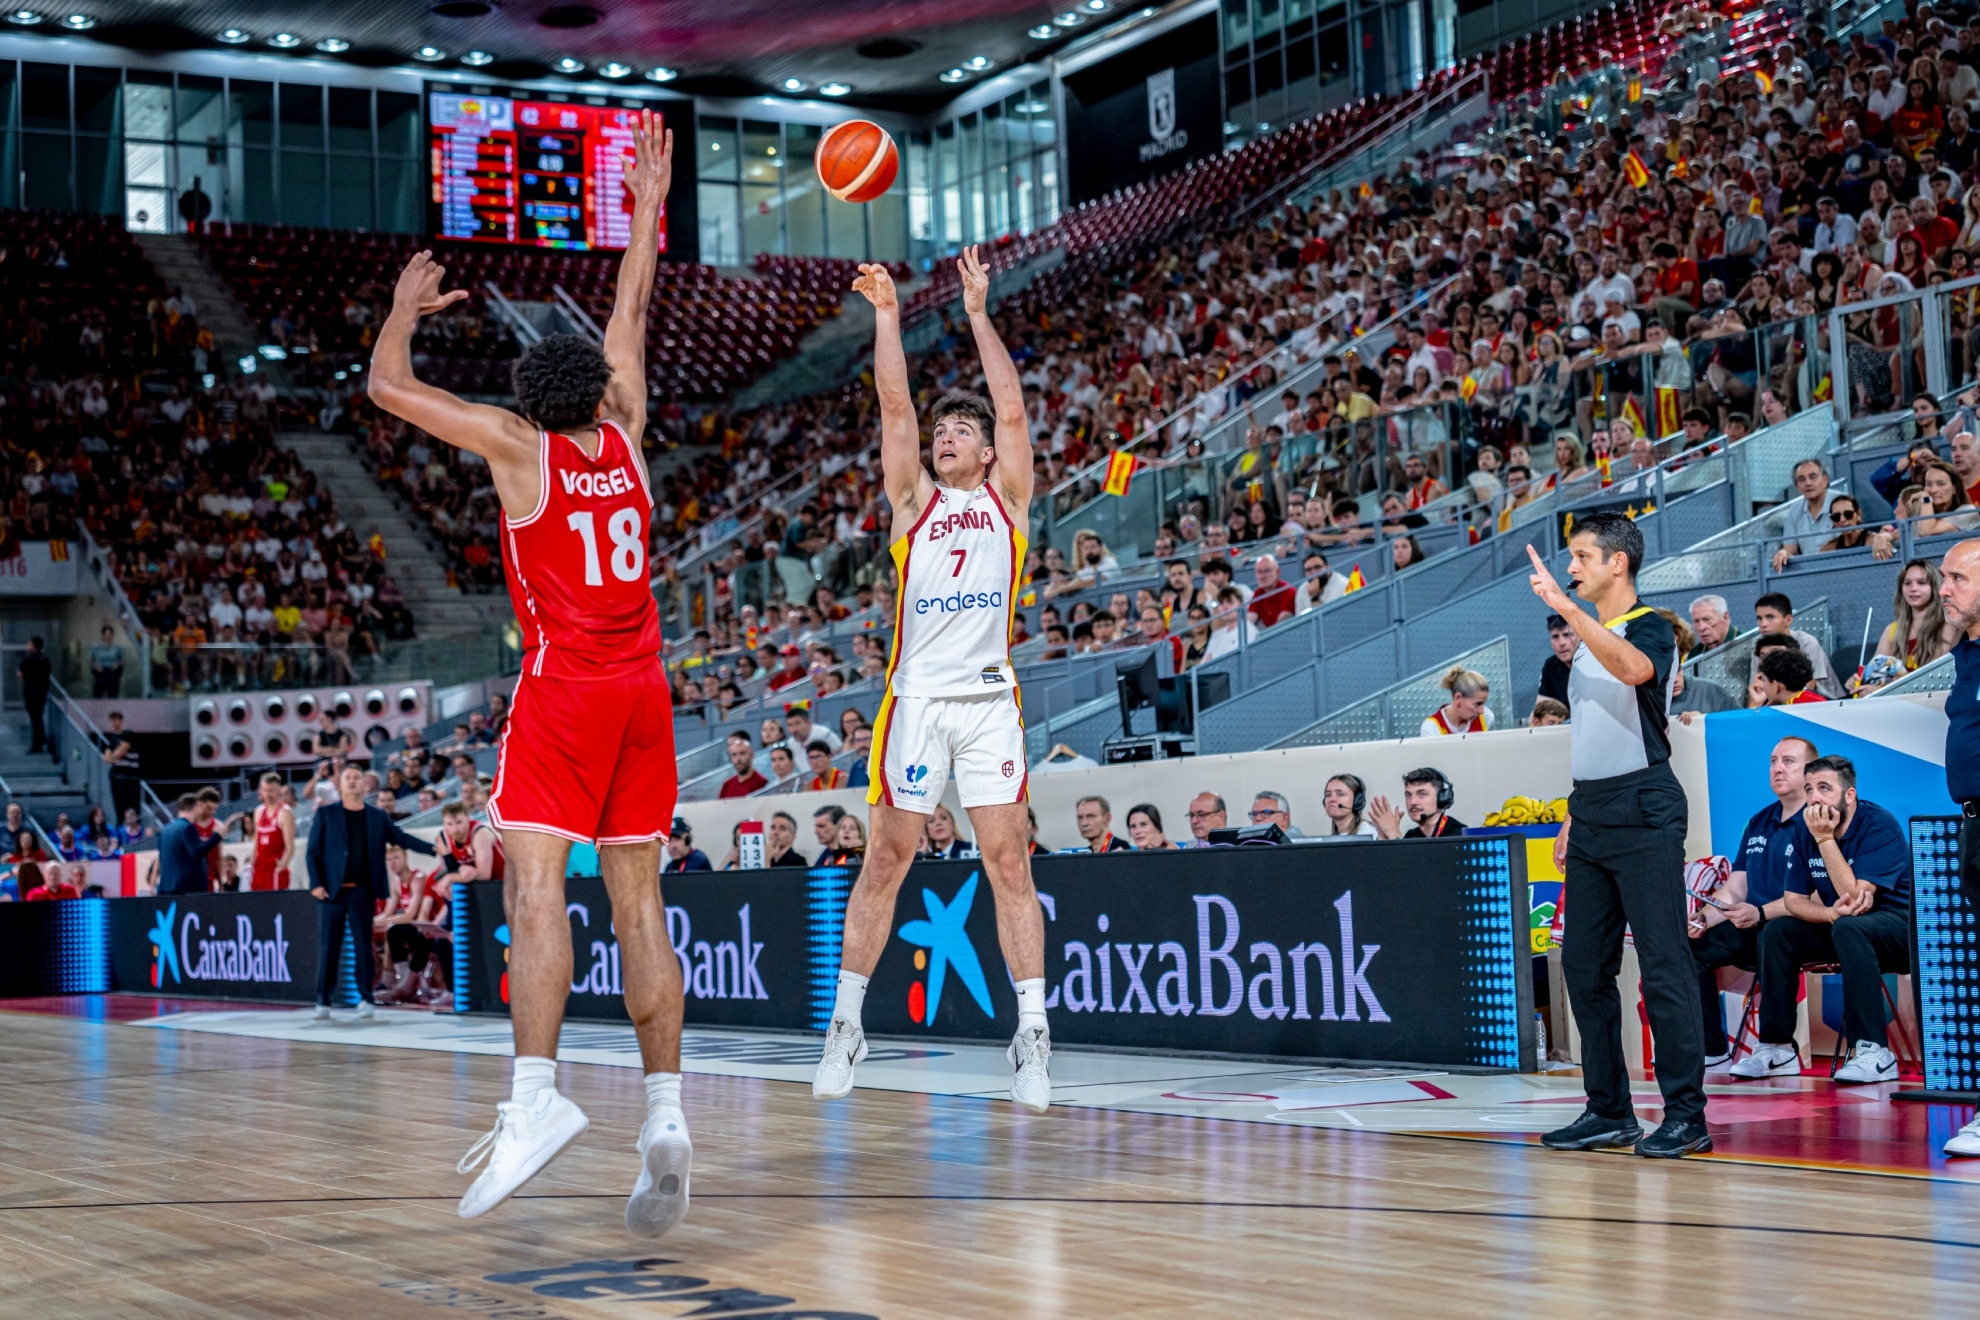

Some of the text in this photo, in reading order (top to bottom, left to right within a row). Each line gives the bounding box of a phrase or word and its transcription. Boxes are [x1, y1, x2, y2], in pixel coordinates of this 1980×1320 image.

[1139, 129, 1188, 163] MADRID
[559, 466, 635, 497] VOGEL
[566, 507, 644, 586] 18
[950, 549, 967, 577] 7
[915, 591, 1002, 614] endesa
[181, 912, 292, 982] CaixaBank
[567, 902, 769, 1000] CaiBank
